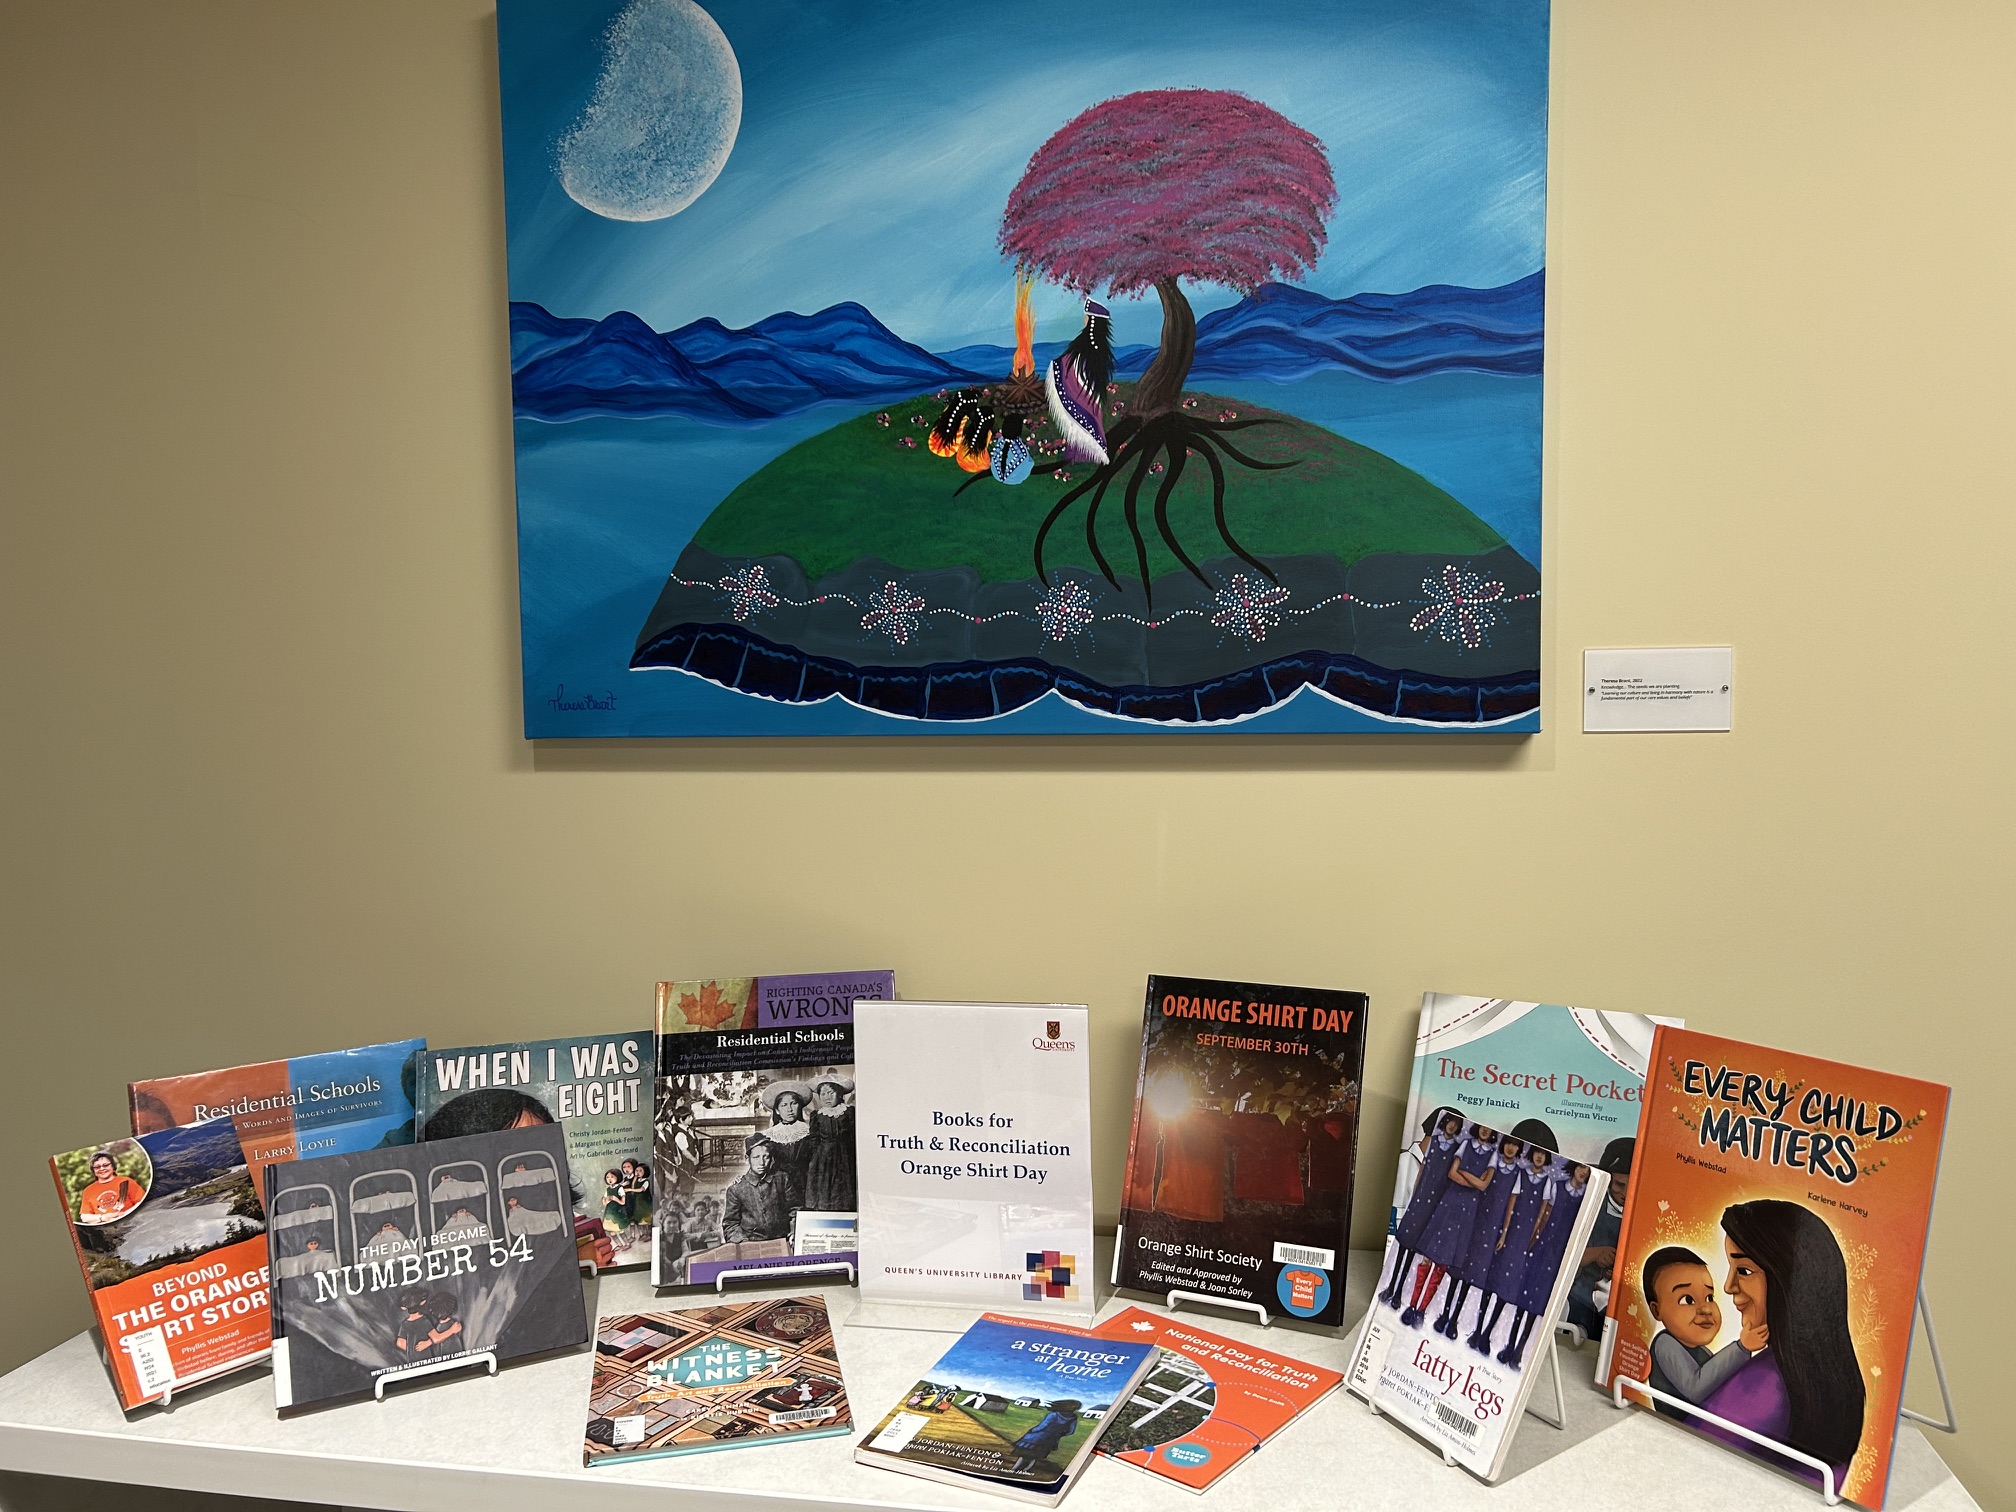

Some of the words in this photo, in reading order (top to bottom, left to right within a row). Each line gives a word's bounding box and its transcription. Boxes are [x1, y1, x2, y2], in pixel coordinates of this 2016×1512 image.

[766, 986, 823, 998] RIGHTING
[827, 982, 883, 994] CANADA'S
[766, 994, 882, 1020] WRON
[1162, 994, 1243, 1023] ORANGE
[1245, 1001, 1308, 1029] SHIRT
[1312, 1008, 1354, 1034] DAY
[716, 1031, 791, 1048] Residential
[794, 1029, 845, 1043] Schools
[1196, 1033, 1271, 1052] SEPTEMBER
[1274, 1041, 1309, 1056] 30TH
[436, 1050, 531, 1092] WHEN
[547, 1048, 556, 1082] I
[570, 1040, 640, 1079] WAS
[1437, 1057, 1476, 1081] The
[1482, 1063, 1557, 1092] Secret
[1566, 1073, 1645, 1103] Pocket
[193, 1087, 304, 1122] Residential
[309, 1075, 382, 1102] Schools
[557, 1078, 641, 1119] EIGHT
[1457, 1093, 1484, 1109] Peggy
[1485, 1097, 1520, 1110] Janicki
[1561, 1099, 1594, 1110] illustrated
[1595, 1103, 1603, 1112] by
[1683, 1059, 1795, 1121] EVERY
[1799, 1087, 1903, 1141] CHILD
[932, 1111, 984, 1127] Books
[989, 1112, 1014, 1128] for
[1545, 1106, 1591, 1120] Carrielynn
[1592, 1112, 1618, 1123] Victor
[569, 1130, 590, 1138] Christy
[592, 1126, 633, 1136] Jordan-Fenton
[575, 1141, 602, 1149] Margaret
[603, 1136, 643, 1146] Pokiak-Fenton
[877, 1134, 924, 1150] Truth
[929, 1136, 944, 1151] &
[949, 1137, 1071, 1156] Reconciliation
[587, 1149, 613, 1158] Gabrielle
[615, 1146, 639, 1155] Grimard
[1700, 1106, 1859, 1185] MATTERS
[900, 1159, 962, 1180] Orange
[966, 1162, 1008, 1178] Shirt
[1013, 1165, 1048, 1184] Day
[1676, 1152, 1696, 1166] Phyllis
[1698, 1158, 1727, 1174] Webstad
[1807, 1191, 1837, 1208] Karlene
[1839, 1200, 1869, 1218] Harvey
[360, 1242, 390, 1259] THE
[392, 1238, 419, 1253] DAY
[422, 1236, 427, 1248] I
[430, 1225, 488, 1247] BECAME
[1138, 1236, 1182, 1257] Orange
[1184, 1243, 1214, 1261] Shirt
[1217, 1249, 1263, 1271] Society
[152, 1262, 228, 1297] BEYOND
[314, 1243, 477, 1303] NUMBER
[488, 1233, 534, 1268] 54
[884, 1266, 923, 1275] QUEEN'S
[926, 1269, 981, 1278] UNIVERSITY
[983, 1272, 1023, 1281] LIBRARY
[1151, 1260, 1174, 1272] Edited
[1176, 1265, 1192, 1275] and
[1193, 1267, 1233, 1283] Approved
[1234, 1275, 1243, 1286] by
[1139, 1270, 1163, 1282] Phyllis
[1164, 1274, 1198, 1288] Webstad
[1199, 1281, 1207, 1290] &
[1207, 1282, 1226, 1293] Joan
[1228, 1285, 1253, 1299] Sorley
[1294, 1284, 1313, 1293] Child
[1295, 1277, 1312, 1286] Every
[111, 1300, 167, 1331] THE
[170, 1264, 270, 1313] ORANGE
[181, 1341, 207, 1355] Phyllis
[207, 1329, 240, 1346] Webstad
[699, 1342, 731, 1353] THE
[1010, 1340, 1026, 1350] a
[1028, 1342, 1131, 1367] stranger
[371, 1365, 398, 1377] WRITTEN
[403, 1355, 442, 1369] ILLUSTRATED
[451, 1350, 471, 1358] LORRIE
[472, 1344, 498, 1354] GALLANT
[647, 1346, 782, 1372] WITNESS
[1034, 1355, 1052, 1364] at
[1046, 1358, 1112, 1378] home
[1165, 1328, 1225, 1352] National
[1227, 1347, 1254, 1362] Day
[1256, 1357, 1279, 1370] for
[1280, 1364, 1320, 1383] Truth
[1181, 1342, 1210, 1357] and
[1210, 1352, 1310, 1390] Reconciliation
[646, 1361, 782, 1387] BLANKET
[1411, 1339, 1463, 1395] fatty
[1460, 1365, 1505, 1421] legs
[646, 1391, 674, 1401] Truth,
[676, 1389, 693, 1397] Art
[693, 1387, 715, 1396] and
[717, 1379, 787, 1393] Reconciliation
[991, 1451, 1002, 1459] &
